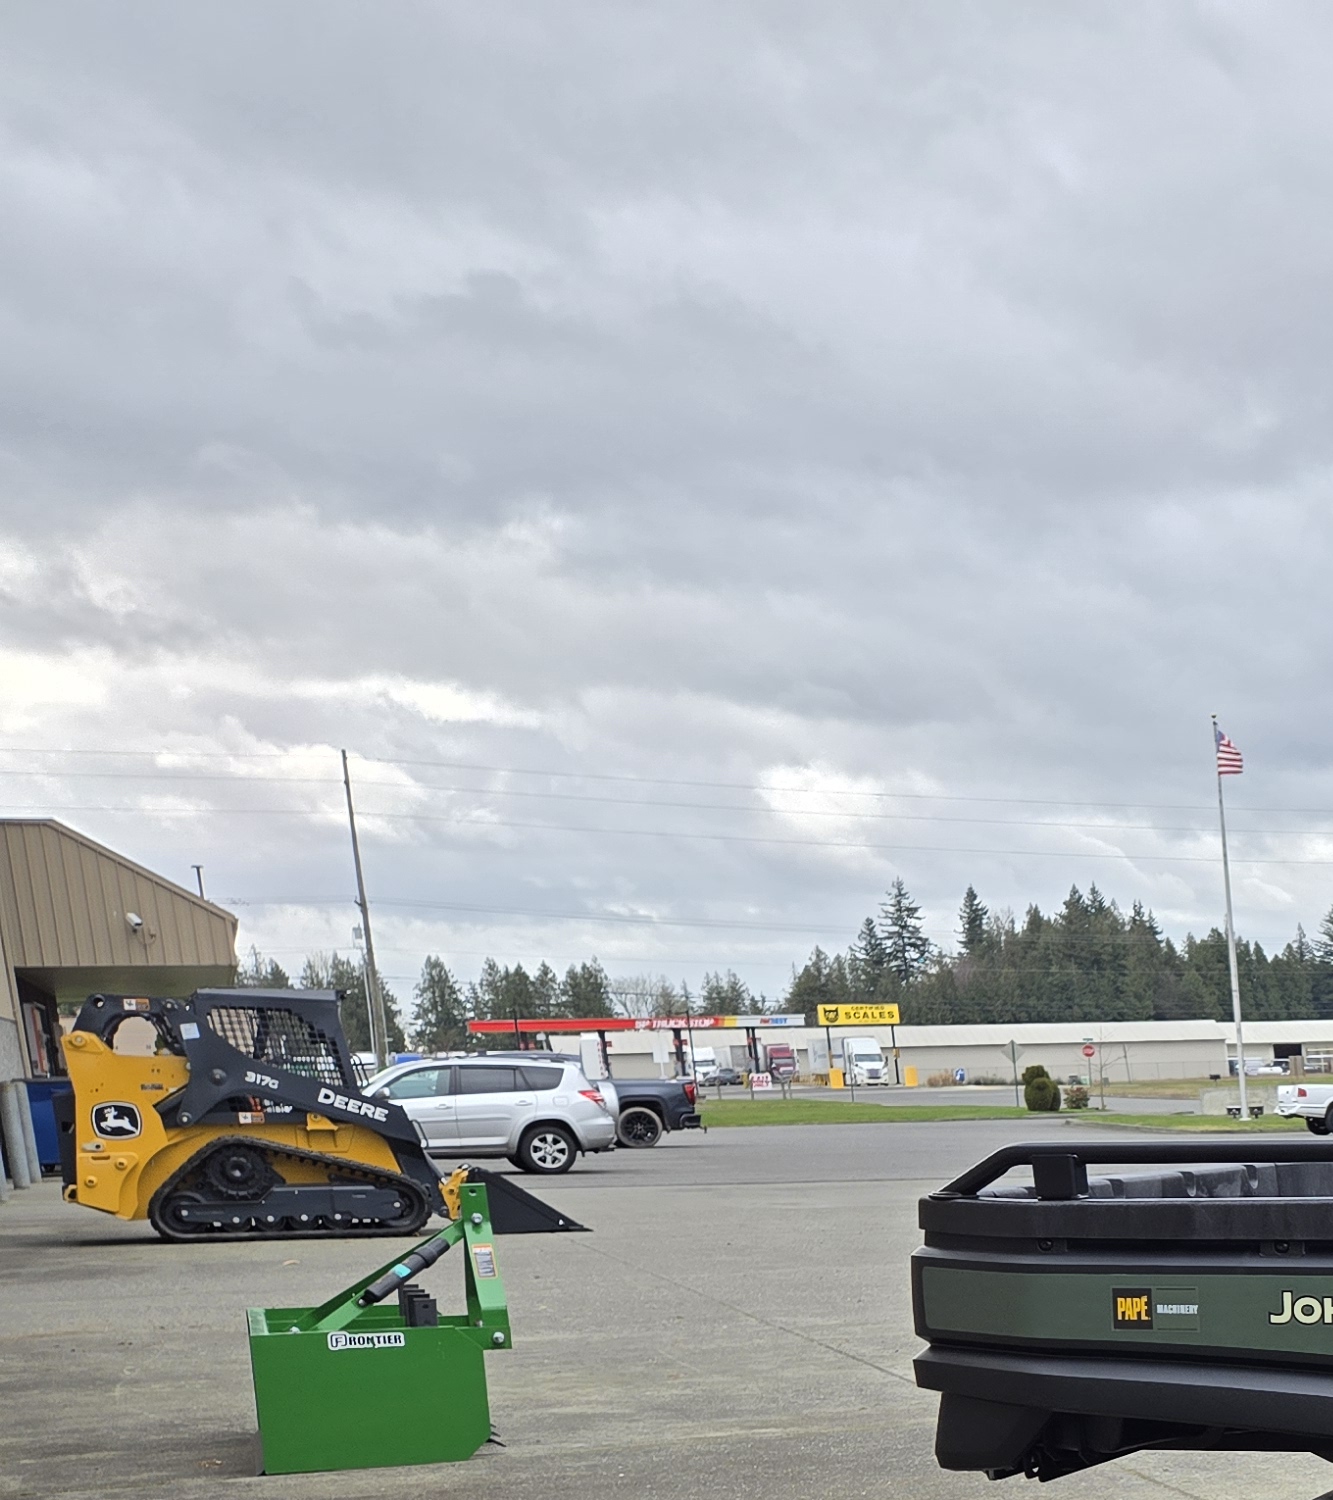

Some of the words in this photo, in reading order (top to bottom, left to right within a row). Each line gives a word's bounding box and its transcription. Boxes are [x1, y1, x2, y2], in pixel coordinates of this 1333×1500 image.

[845, 1011, 895, 1020] SCALES
[652, 1019, 687, 1028] TRUCK
[689, 1018, 715, 1027] STOP
[317, 1087, 389, 1122] DEERE
[1156, 1304, 1199, 1315] MACHINERY
[330, 1333, 402, 1348] FRONTIER
